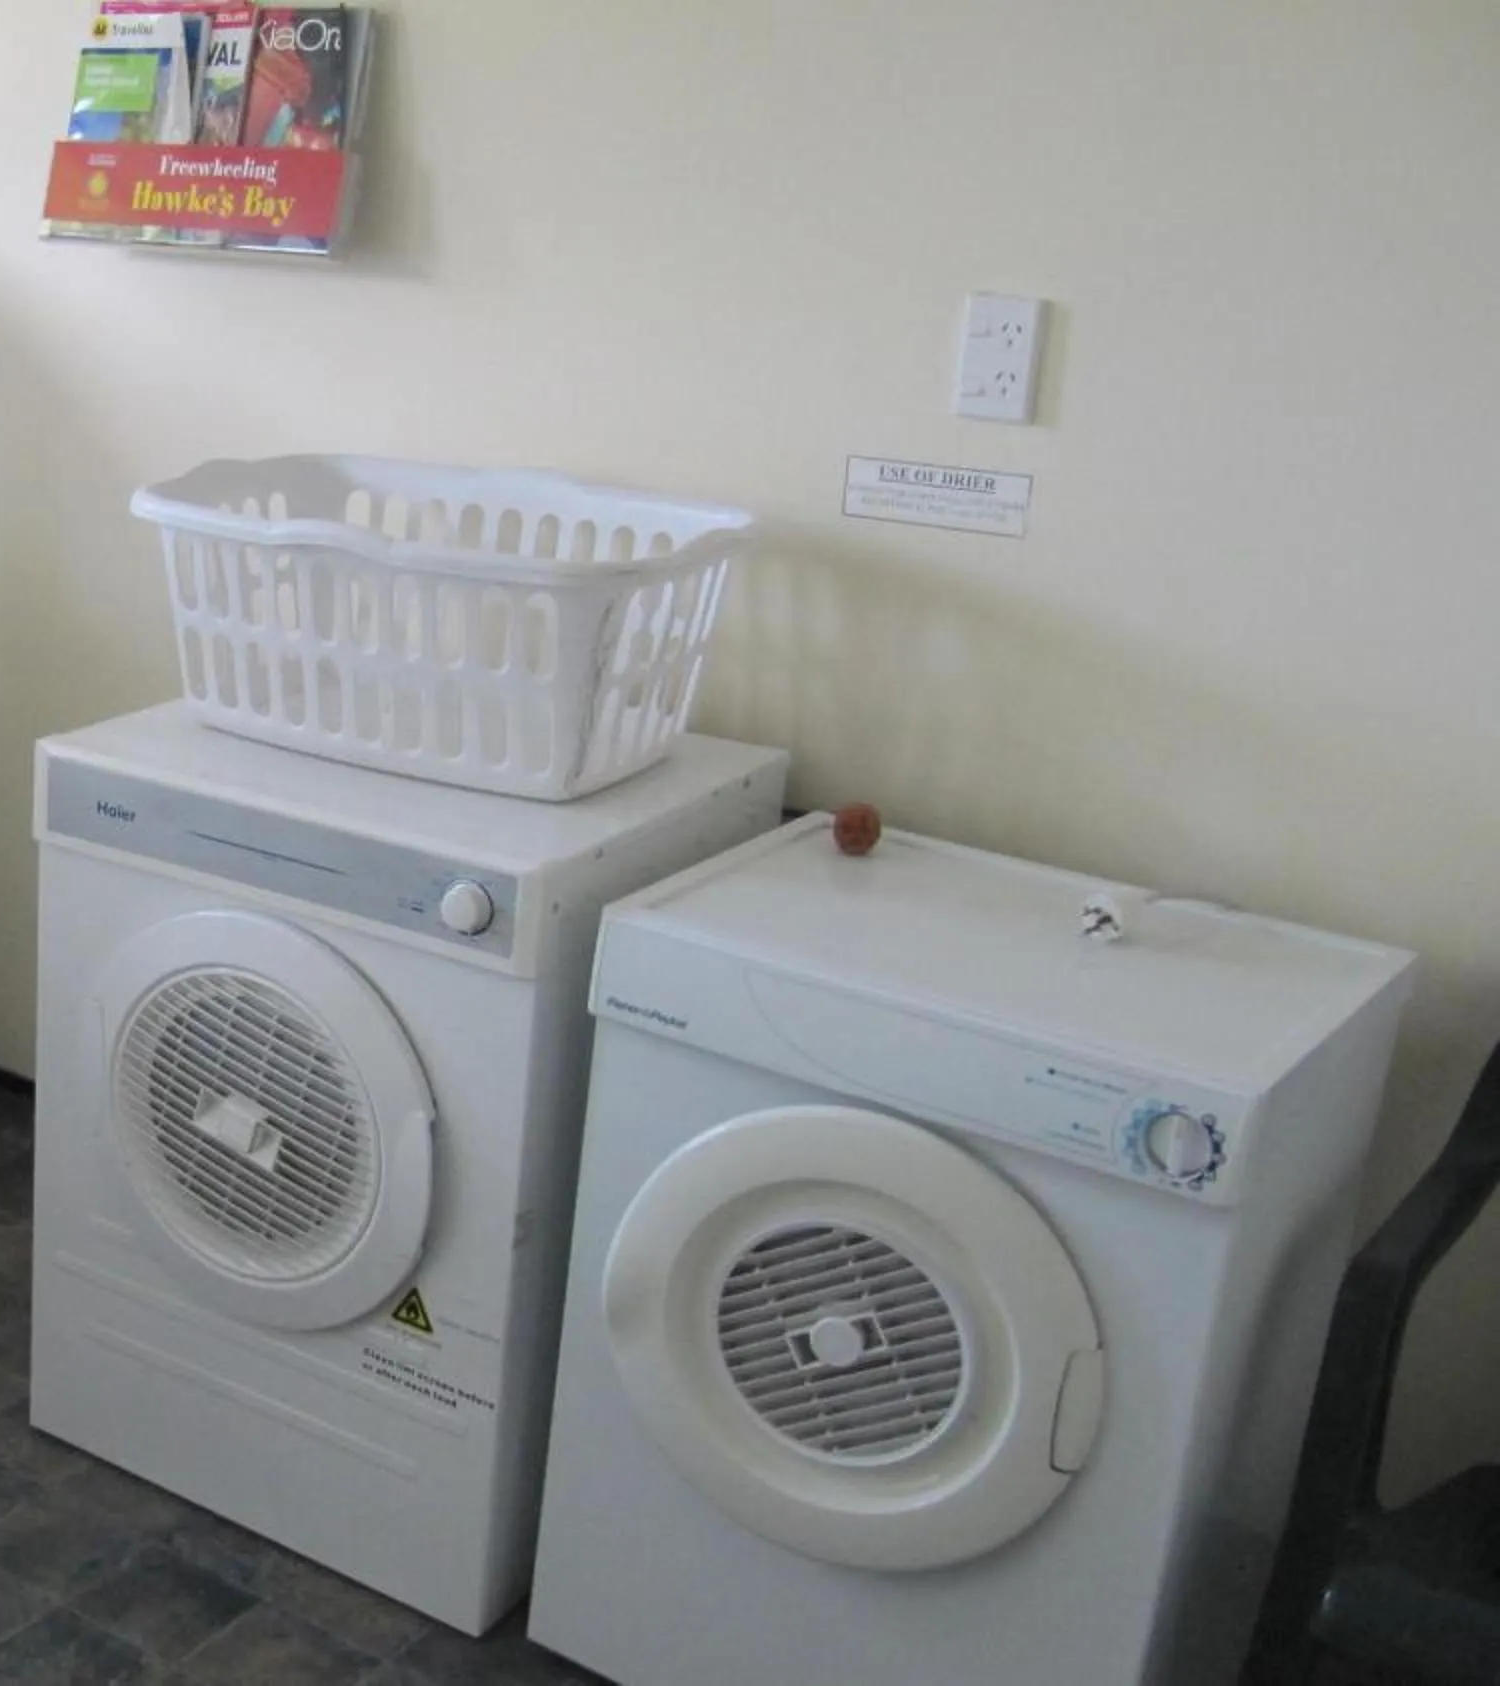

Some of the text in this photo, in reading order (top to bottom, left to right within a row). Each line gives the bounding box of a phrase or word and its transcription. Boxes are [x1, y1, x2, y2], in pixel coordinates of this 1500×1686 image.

[159, 154, 279, 187] Freewheeling
[879, 463, 996, 491] USE OF DRIER
[97, 800, 137, 823] Haier
